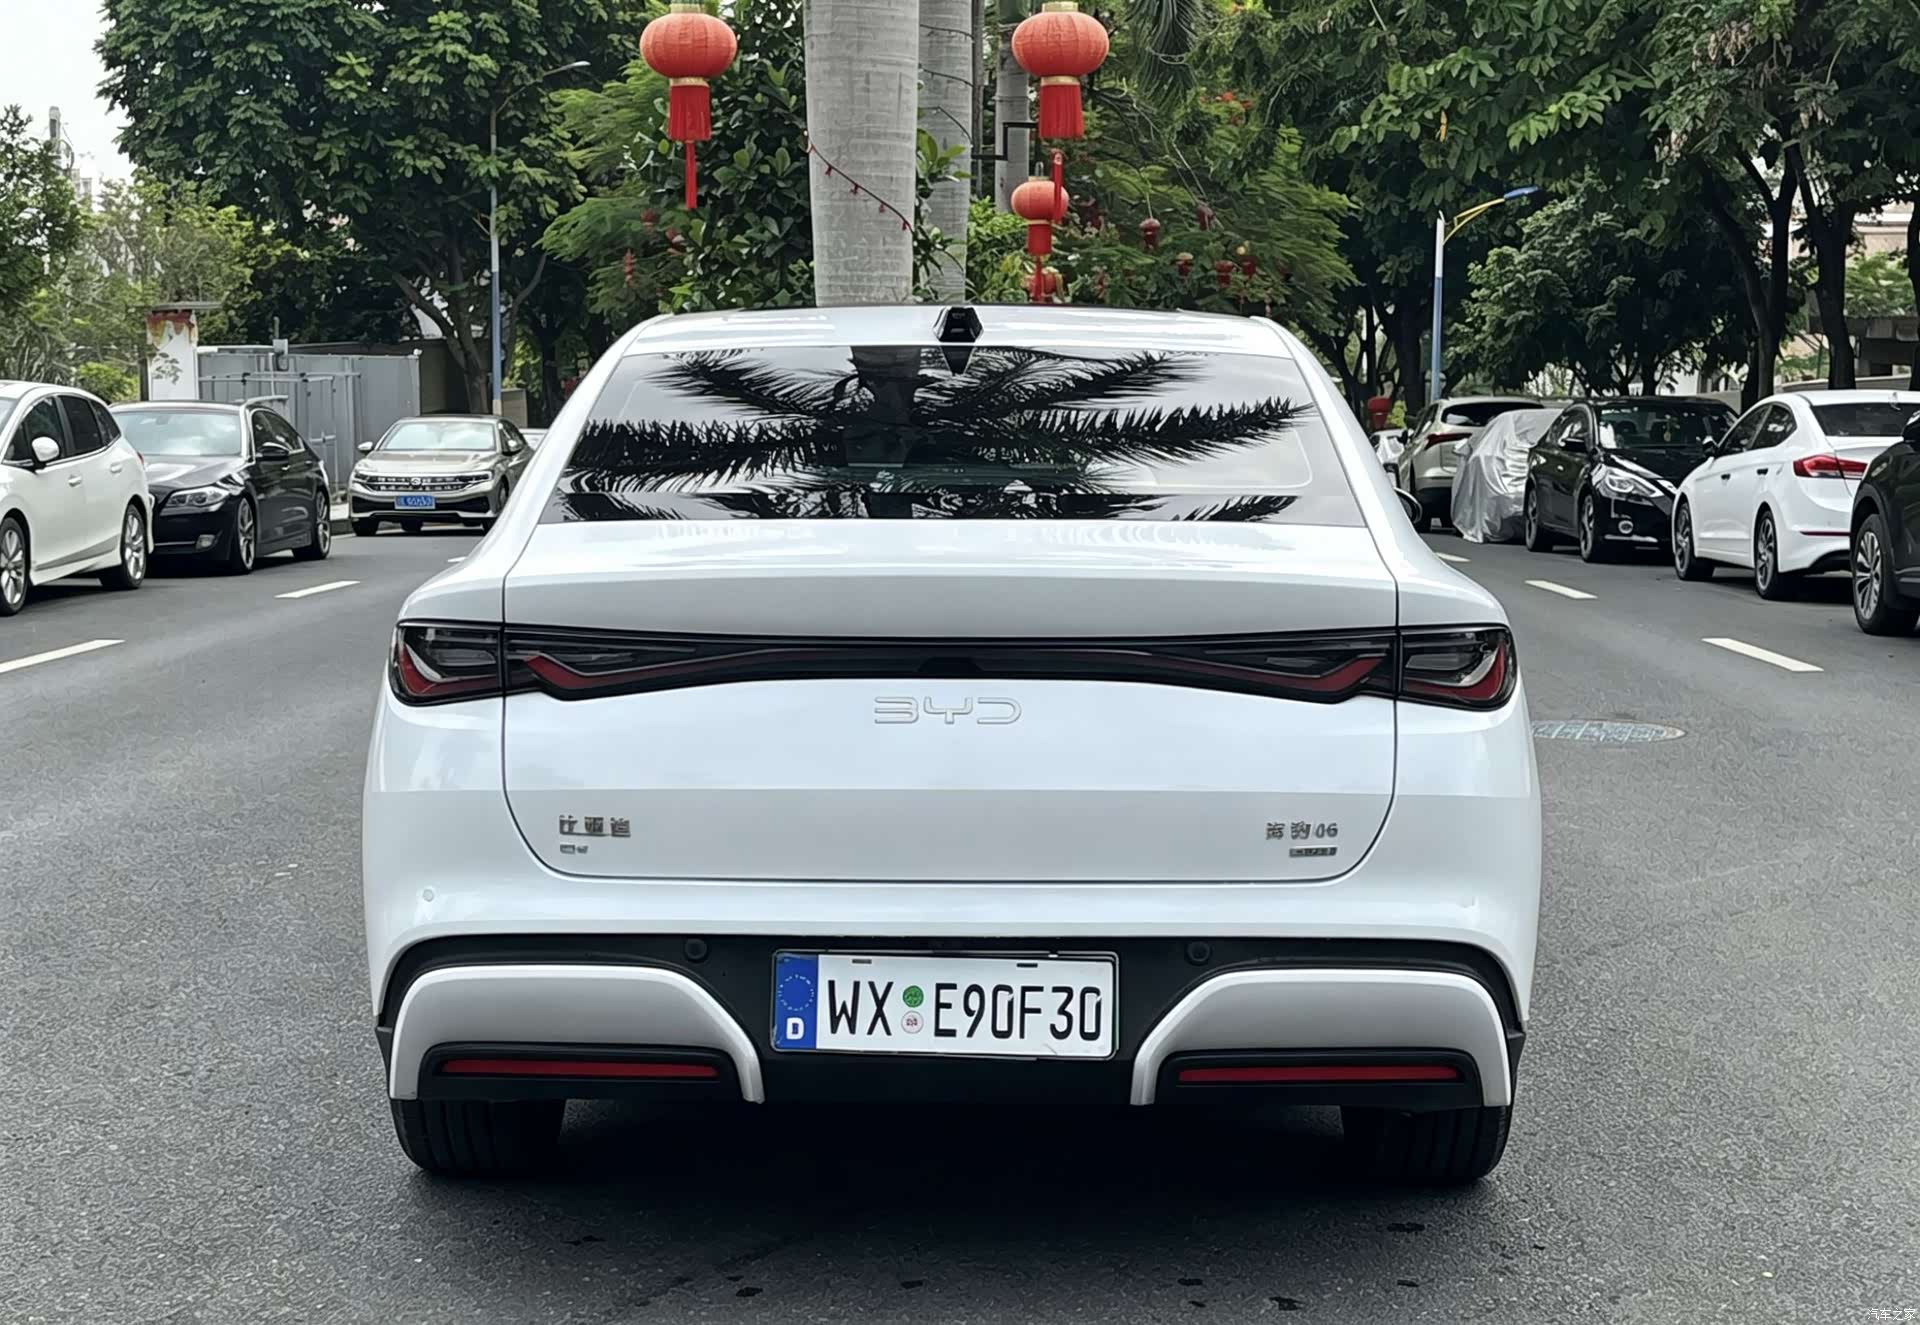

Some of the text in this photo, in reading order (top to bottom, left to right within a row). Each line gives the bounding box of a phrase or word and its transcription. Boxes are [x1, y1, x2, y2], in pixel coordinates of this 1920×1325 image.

[874, 696, 1022, 725] BYD
[827, 979, 1103, 1041] WX E90F30
[786, 1017, 805, 1040] D
